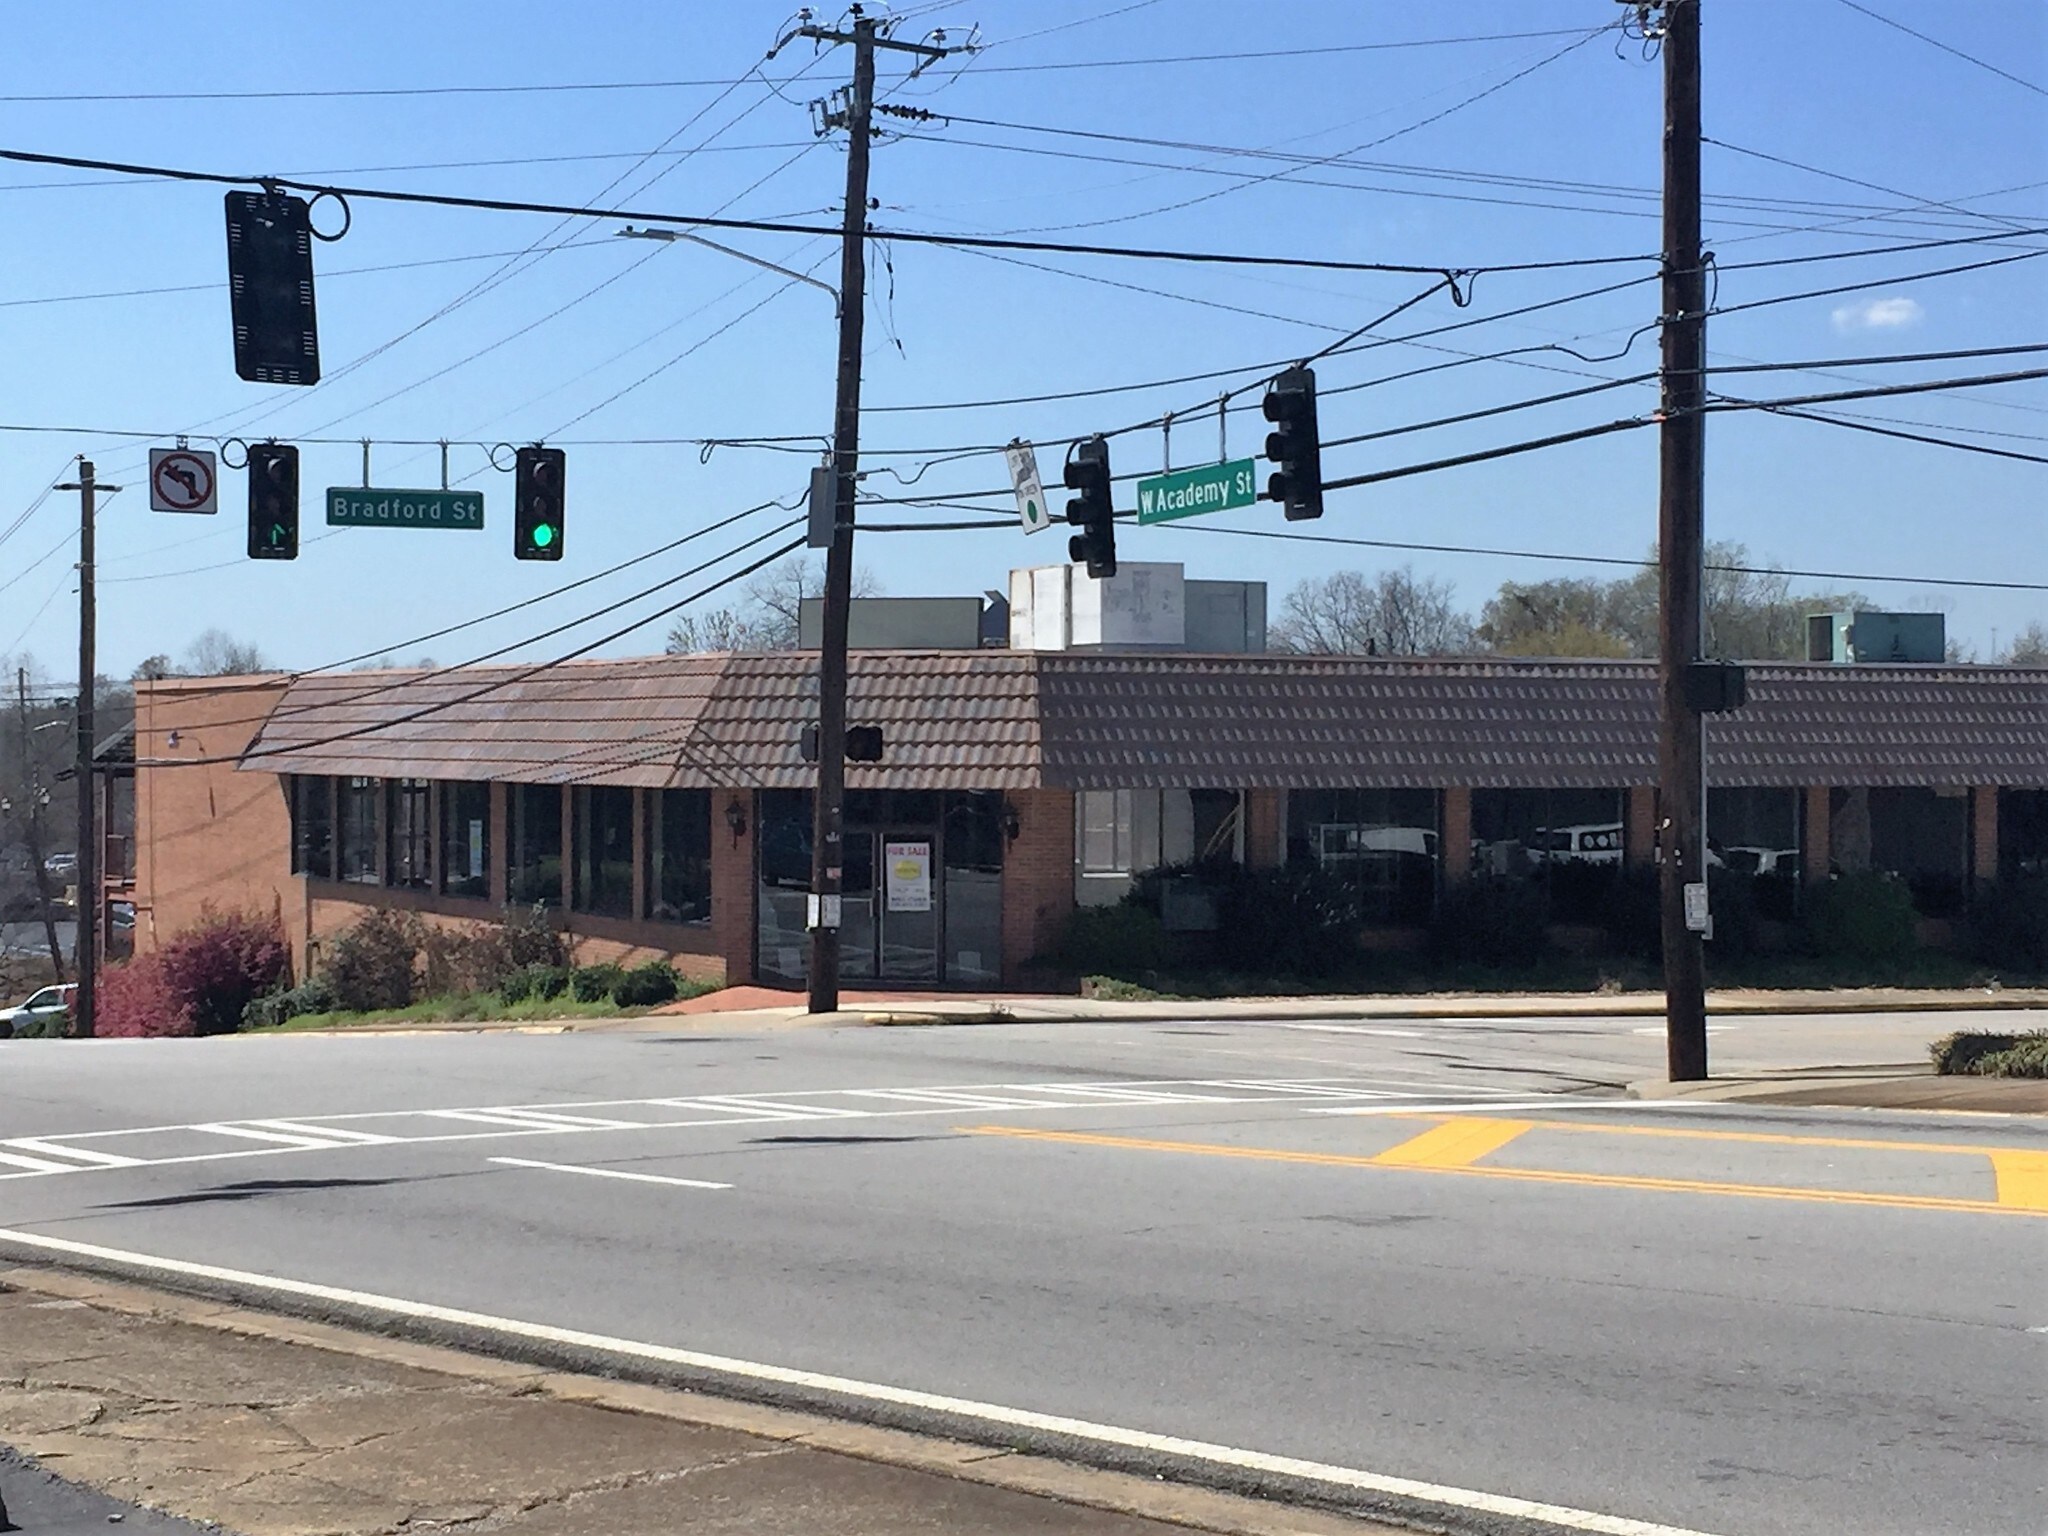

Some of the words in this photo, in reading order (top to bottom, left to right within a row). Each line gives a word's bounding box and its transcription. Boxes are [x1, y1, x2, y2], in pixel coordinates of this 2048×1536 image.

[1157, 480, 1230, 513] Academy
[1236, 470, 1252, 495] St
[333, 497, 442, 520] Bradford
[452, 501, 477, 520] St
[888, 847, 905, 856] FOR
[907, 847, 927, 856] SALE
